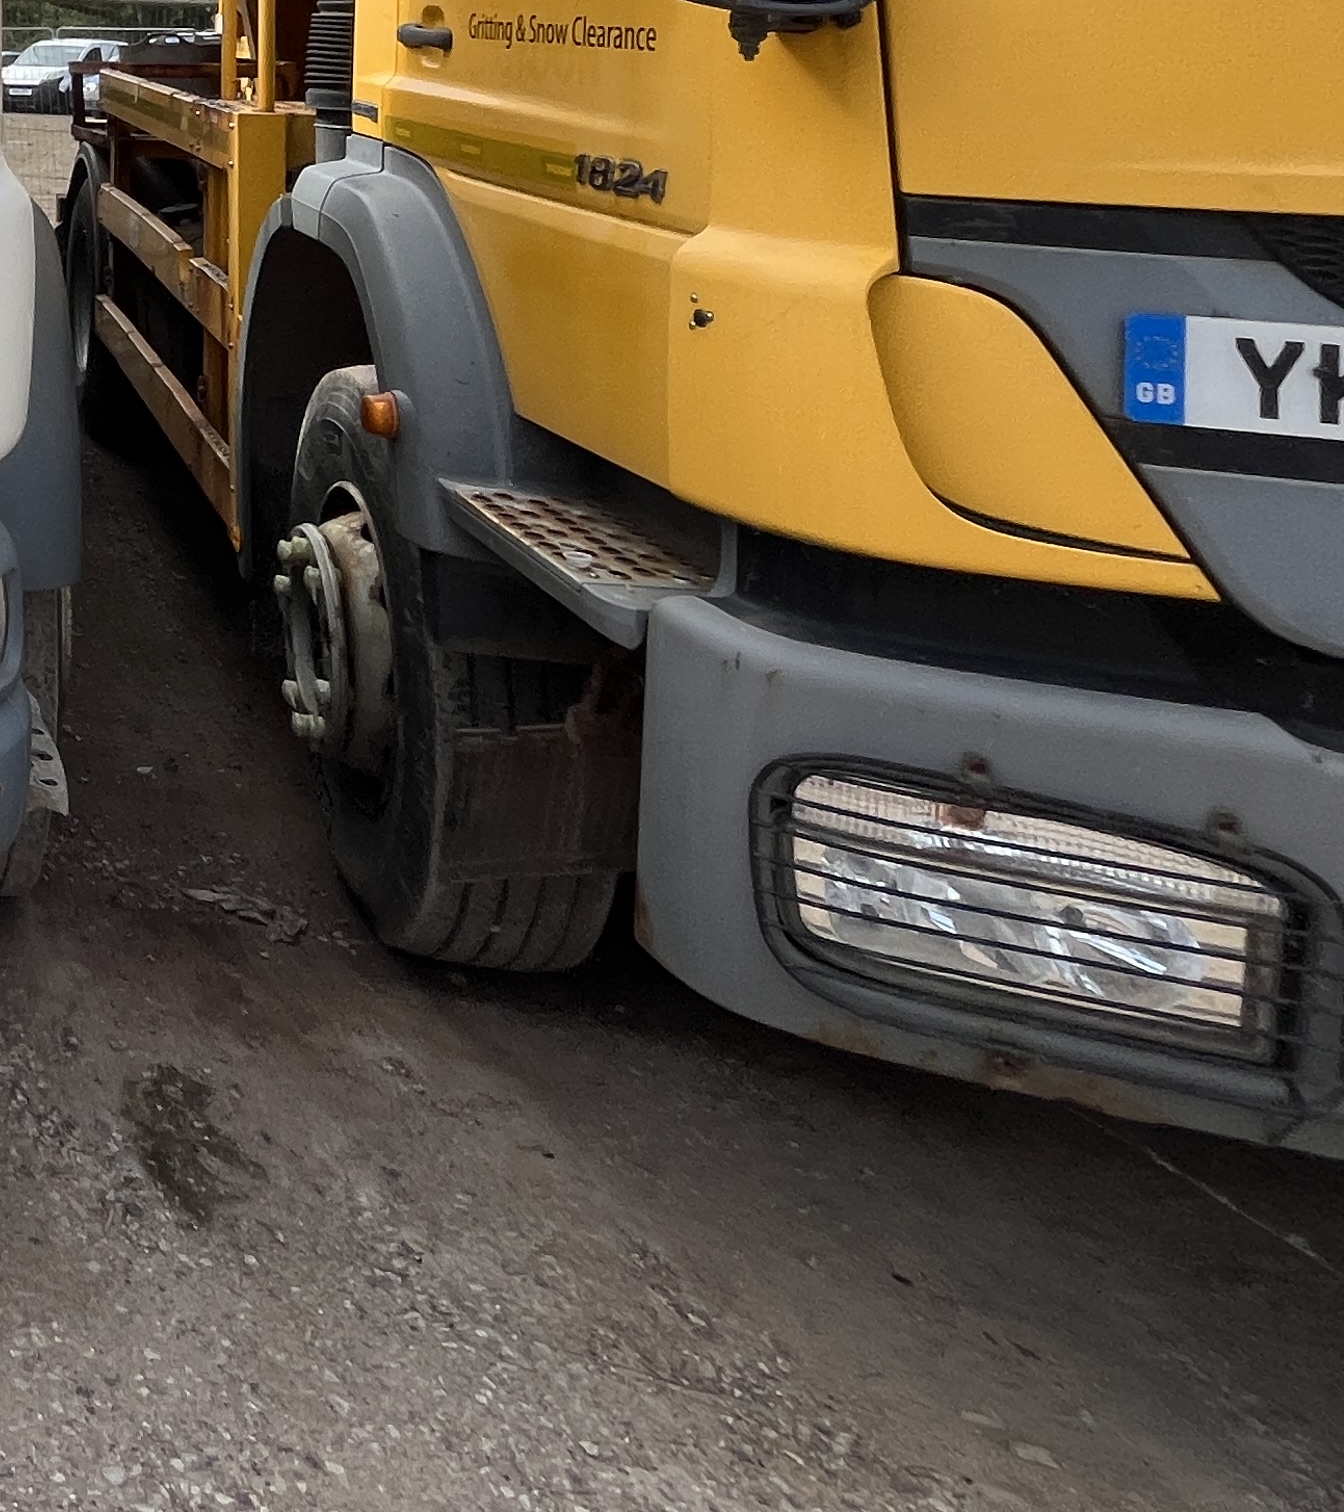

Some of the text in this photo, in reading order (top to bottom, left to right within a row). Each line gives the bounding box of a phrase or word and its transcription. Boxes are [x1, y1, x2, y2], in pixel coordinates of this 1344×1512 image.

[469, 13, 657, 51] Gritting & Snow Clearance
[575, 154, 668, 203] 1824
[1136, 382, 1175, 404] GB
